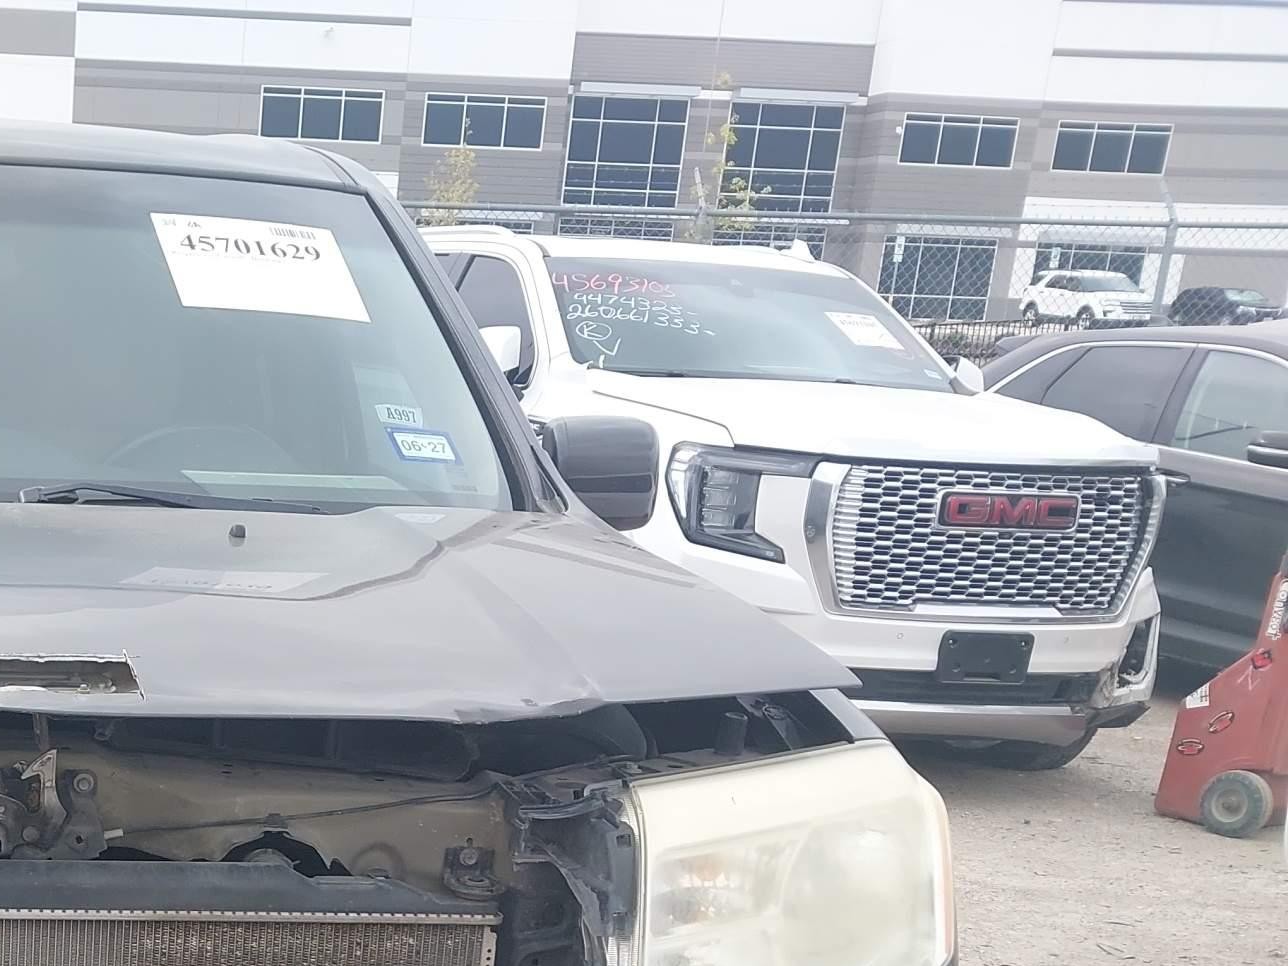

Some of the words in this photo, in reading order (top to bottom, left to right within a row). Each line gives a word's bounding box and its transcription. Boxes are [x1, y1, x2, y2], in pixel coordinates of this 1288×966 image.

[179, 233, 321, 262] 45701629
[386, 407, 417, 423] A997
[944, 492, 1078, 528] GMC
